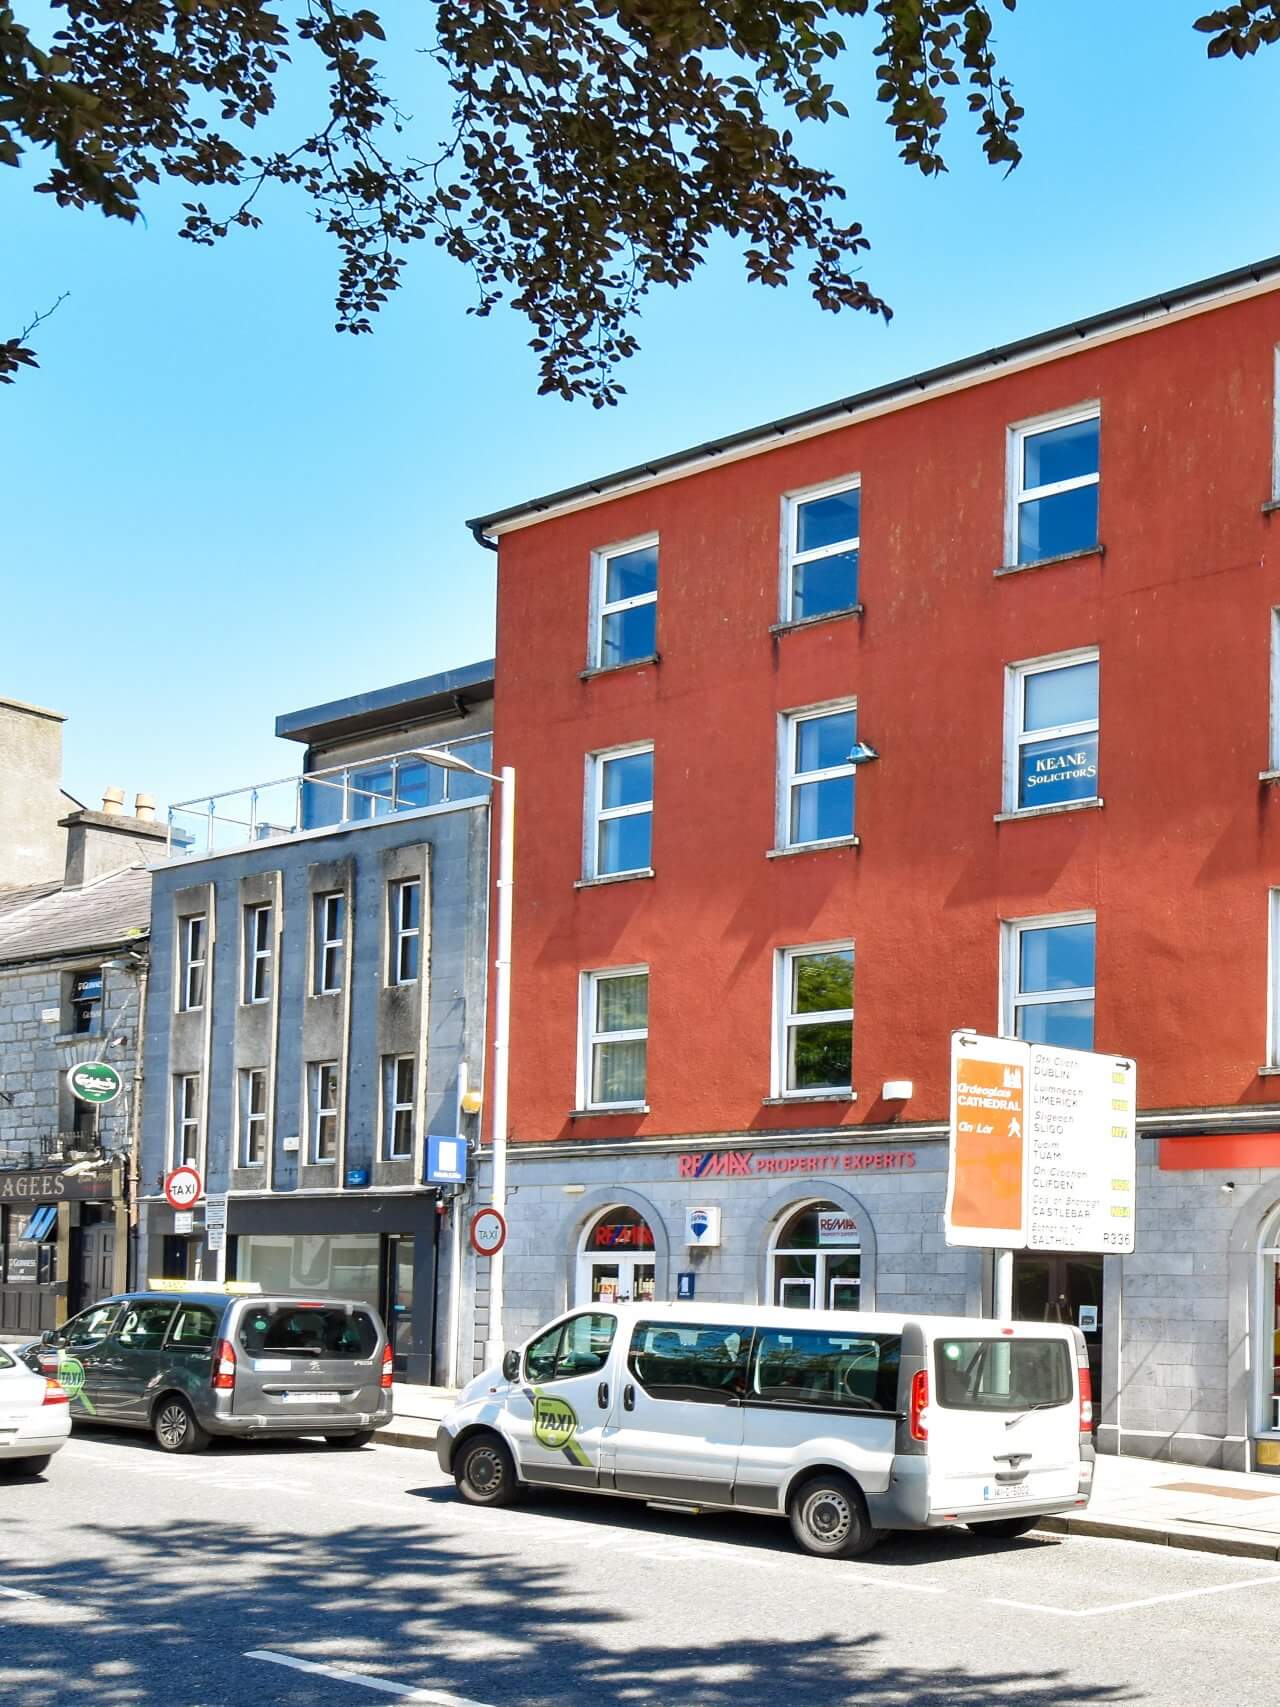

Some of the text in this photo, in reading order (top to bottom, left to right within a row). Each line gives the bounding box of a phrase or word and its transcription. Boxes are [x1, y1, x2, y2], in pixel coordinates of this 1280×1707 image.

[1036, 752, 1087, 772] KEANE
[1034, 1066, 1070, 1079] DUBLIN
[958, 1095, 1022, 1112] CATHEDRAL
[1034, 1095, 1078, 1108] LIMERICK
[1033, 1123, 1064, 1135] SLIGO
[1033, 1150, 1062, 1160] TUAM
[678, 1151, 916, 1178] RE/MAX PROPERTY EXPERTS
[2, 1175, 65, 1197] AGEES
[172, 1184, 195, 1195] TAXI
[1032, 1178, 1073, 1190] CLIFDEN
[1032, 1207, 1090, 1219] CASTLEBAR
[479, 1230, 498, 1240] TAXI
[1032, 1235, 1075, 1246] SALTHILL
[1103, 1233, 1130, 1246] R336
[61, 1372, 80, 1385] TAXI
[539, 1412, 572, 1432] TAXI
